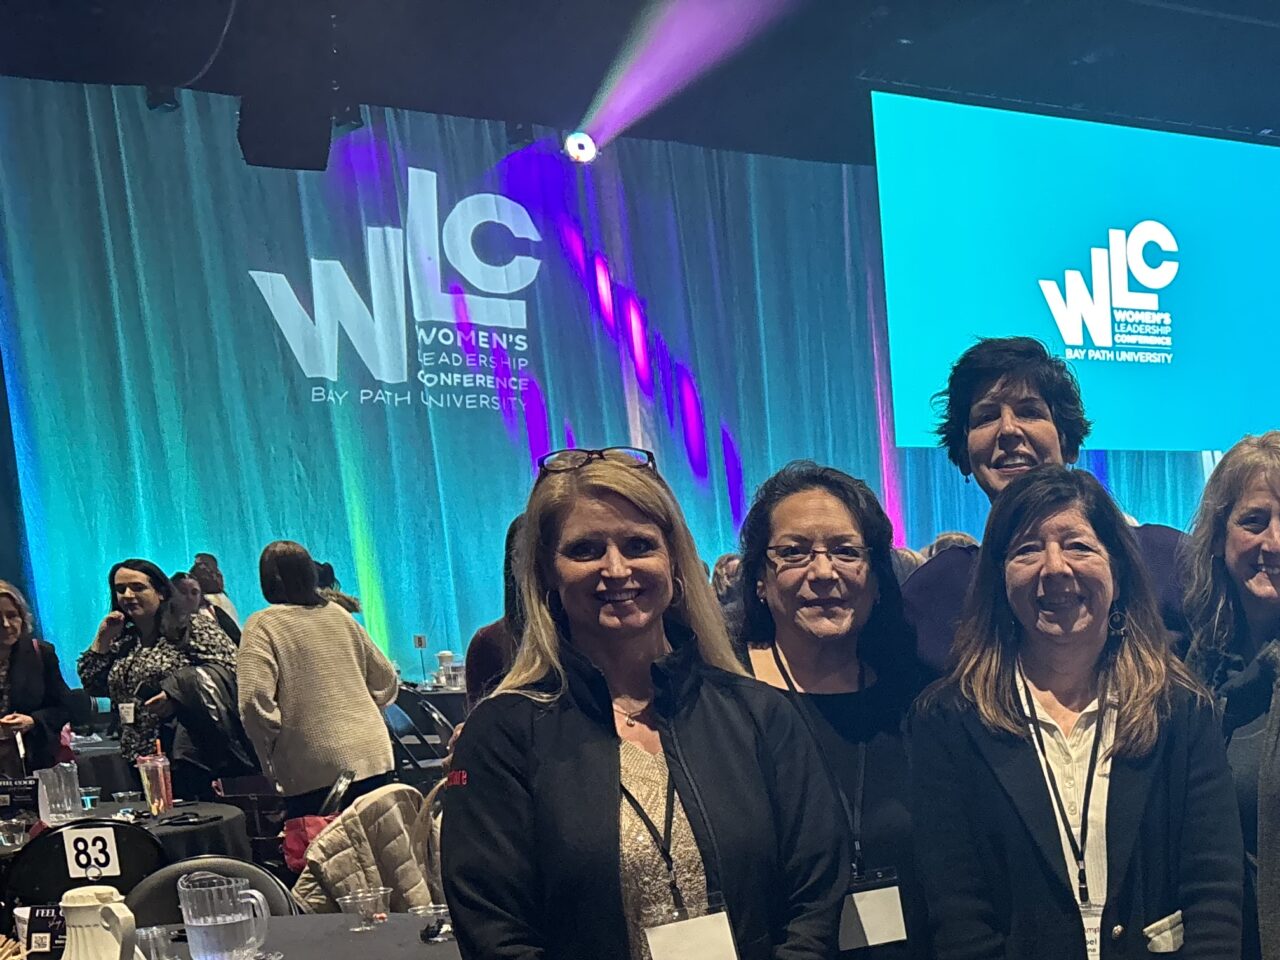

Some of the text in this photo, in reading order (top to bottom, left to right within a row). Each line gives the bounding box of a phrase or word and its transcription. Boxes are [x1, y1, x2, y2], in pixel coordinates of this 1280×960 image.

[248, 167, 542, 383] WLC
[1037, 219, 1179, 347] WLC
[1113, 309, 1172, 325] WOMEN'S
[415, 327, 528, 351] WOMEN'S
[1114, 322, 1172, 335] LEADERSHIP
[418, 352, 529, 371] LEADERSHIP
[1065, 348, 1174, 364] BAY PATH UNIVERSITY
[417, 370, 529, 391] CONFERENCE
[311, 387, 528, 411] BAY PATH UNIVERSITY
[73, 836, 110, 869] 83
